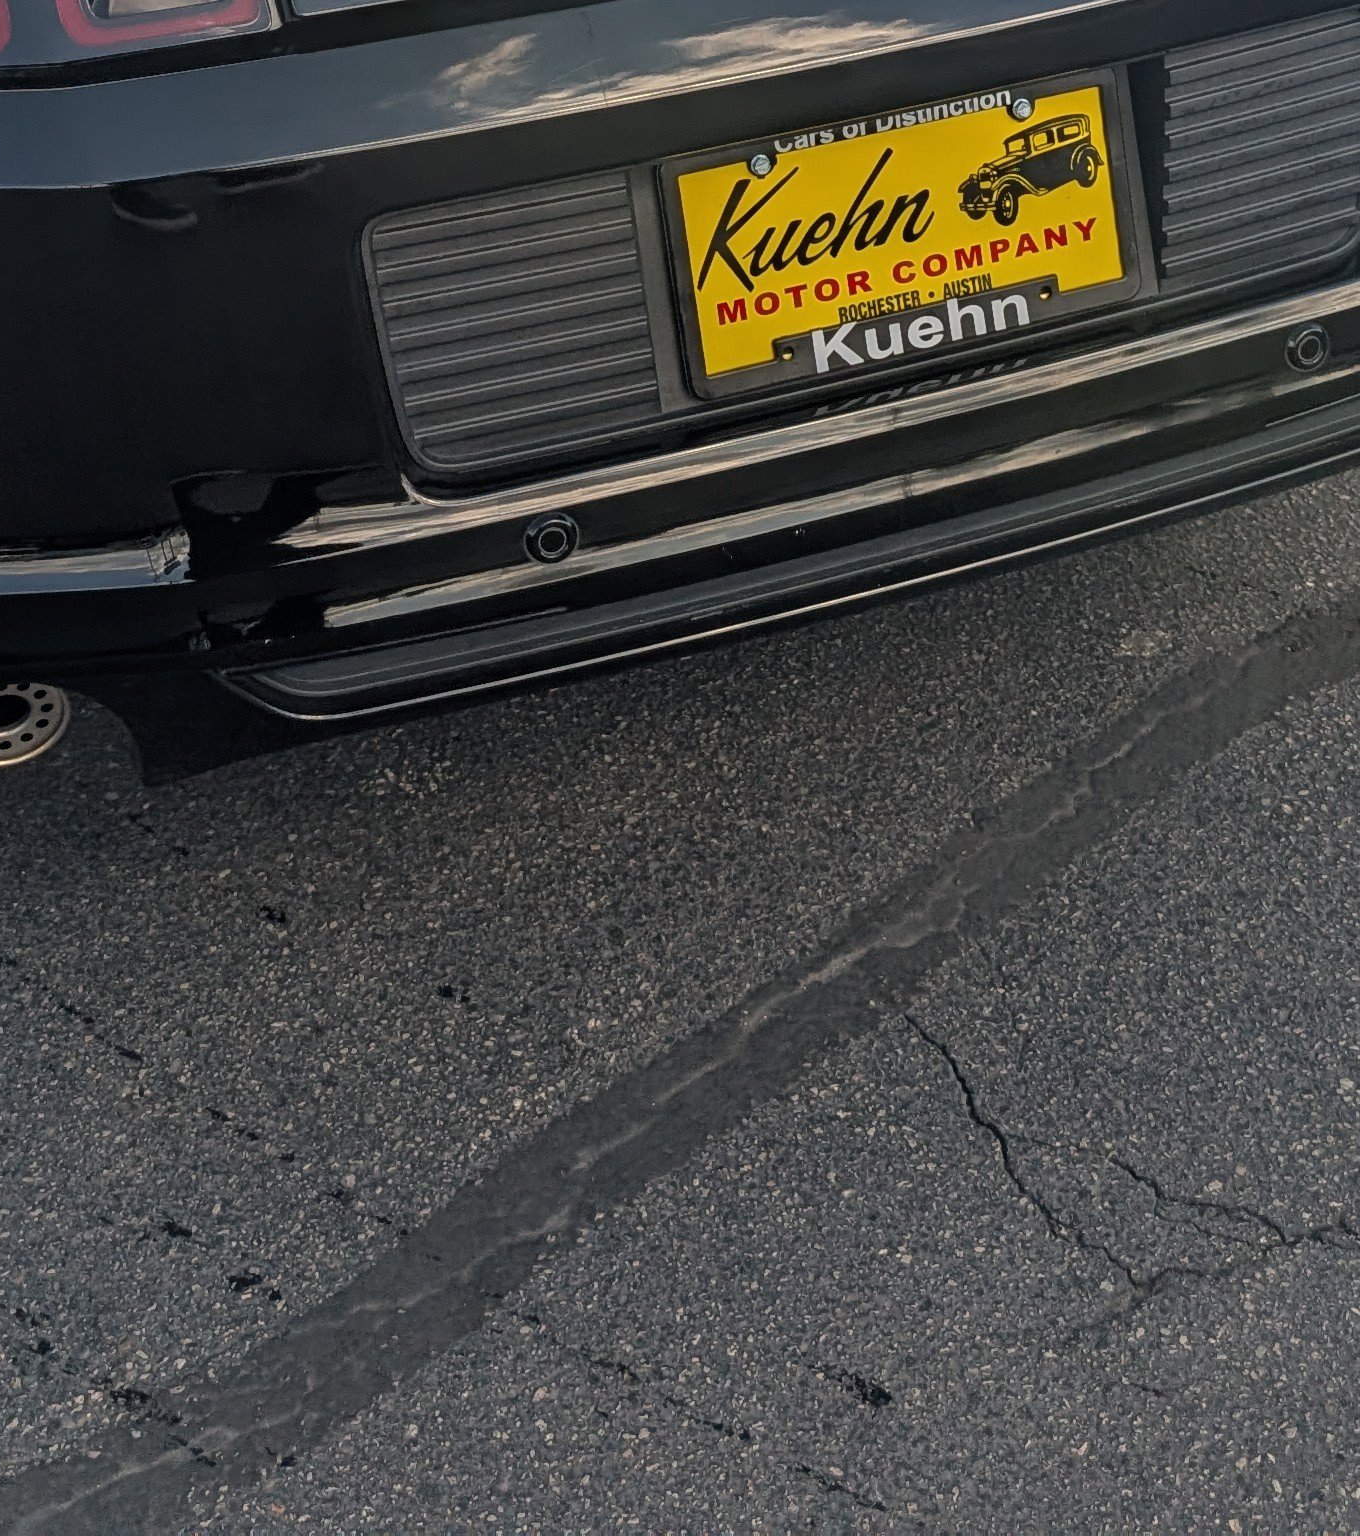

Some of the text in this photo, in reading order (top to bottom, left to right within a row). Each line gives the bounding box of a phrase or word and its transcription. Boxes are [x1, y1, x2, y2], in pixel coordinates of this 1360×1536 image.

[774, 128, 835, 153] Cars
[876, 90, 1012, 133] Distinction
[697, 147, 936, 293] Kuehn
[716, 216, 1097, 326] MOTOR COMPANY
[838, 273, 993, 324] ROCHESTER AUSTIN
[811, 292, 1031, 373] Kuehn
